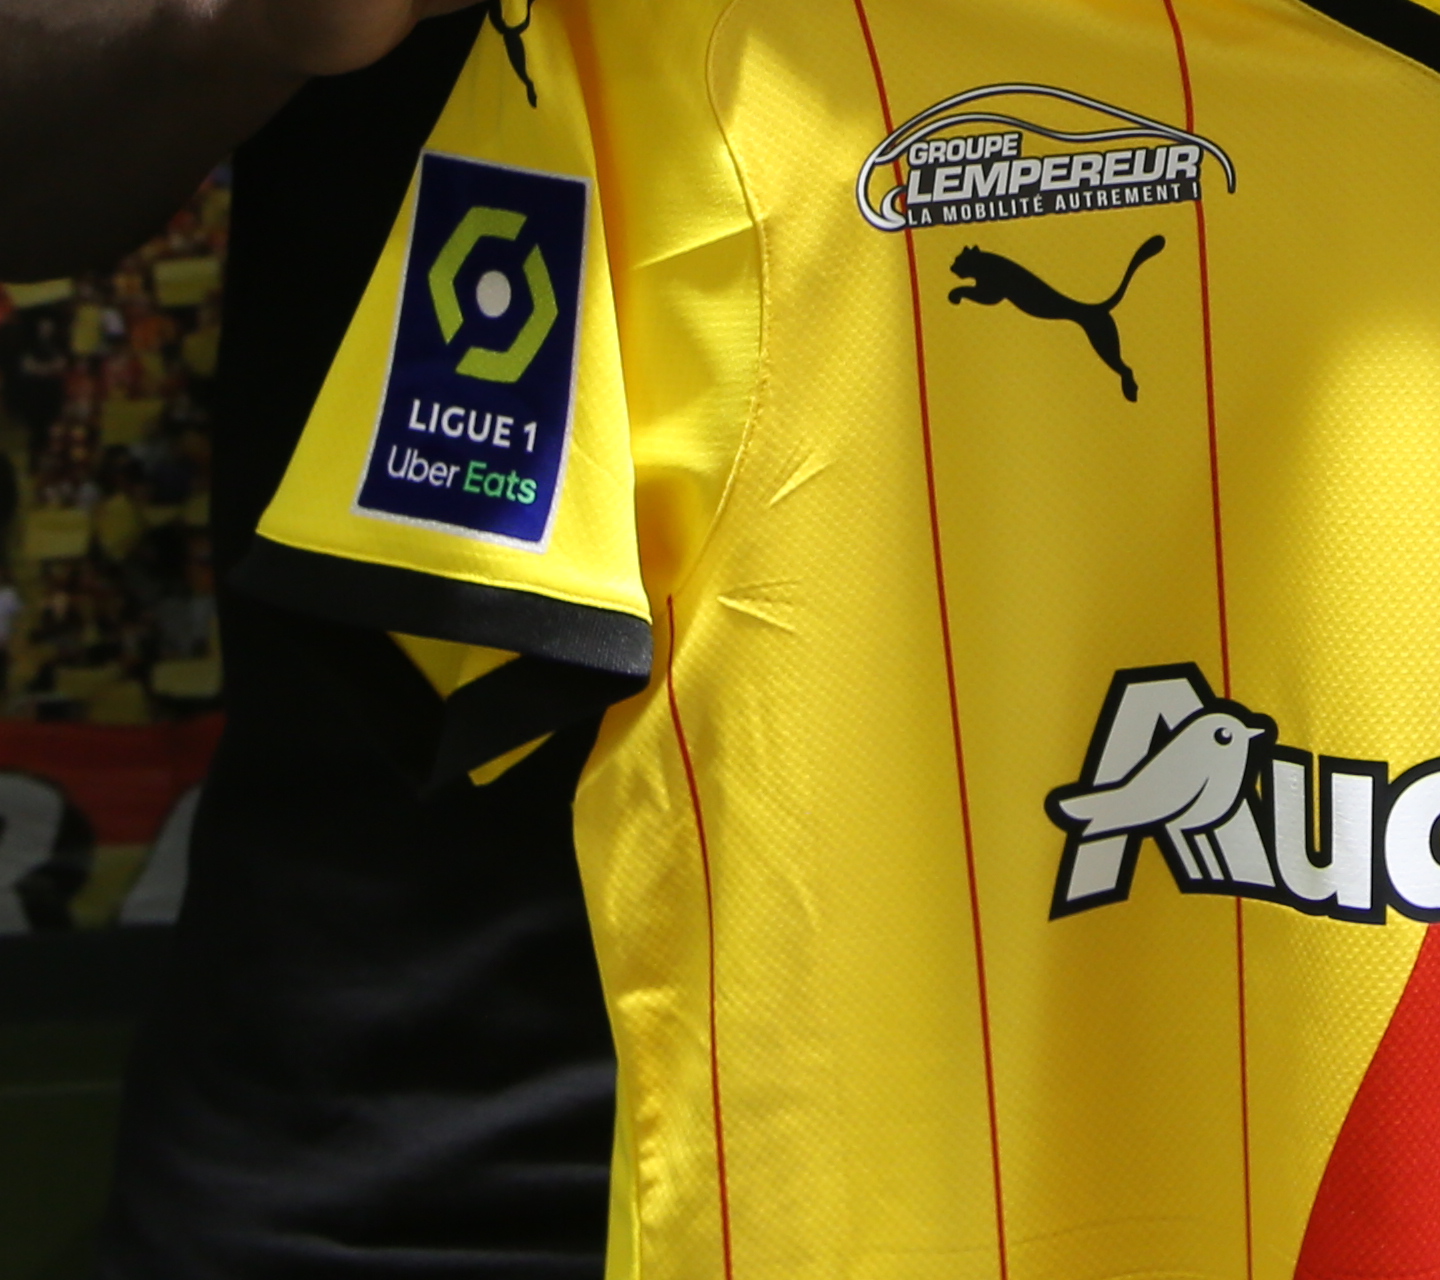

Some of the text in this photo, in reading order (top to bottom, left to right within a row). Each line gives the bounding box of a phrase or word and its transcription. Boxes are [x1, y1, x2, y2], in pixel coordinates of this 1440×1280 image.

[906, 144, 1202, 206] LEMPEREUR
[908, 132, 1020, 166] GROUPE
[907, 206, 932, 226] LA
[943, 194, 1045, 224] MOBILITÉ
[1055, 184, 1182, 212] AUTREMENT
[407, 398, 539, 453] LIGUE 1
[387, 444, 538, 504] Uber Eats
